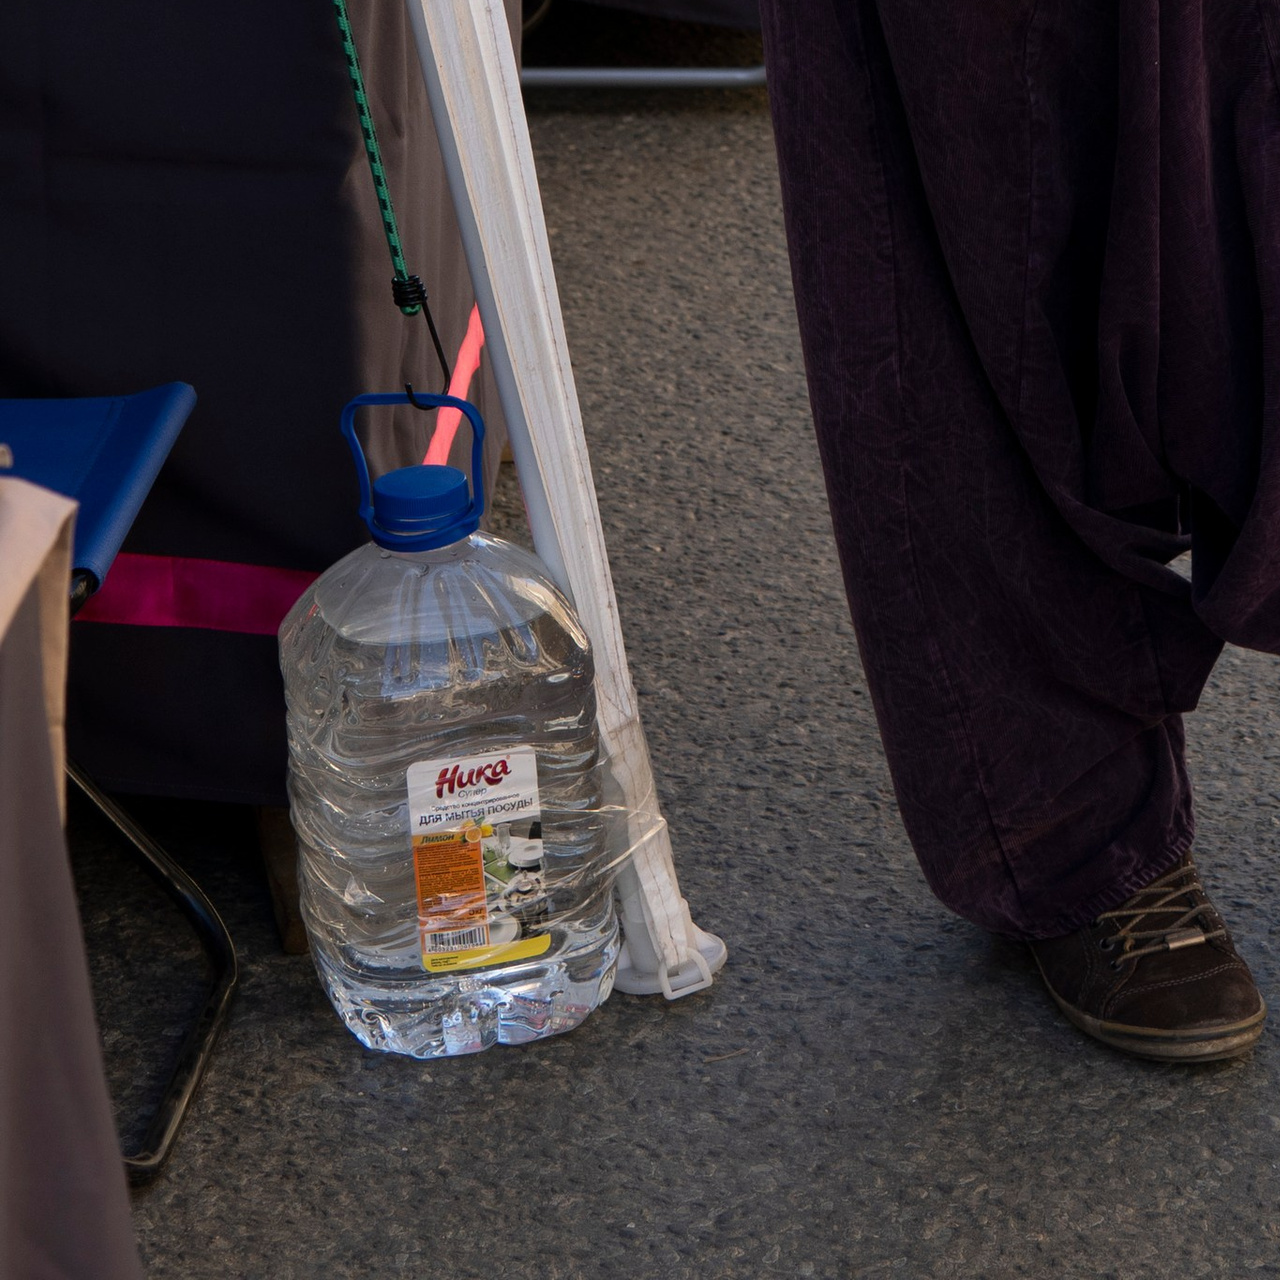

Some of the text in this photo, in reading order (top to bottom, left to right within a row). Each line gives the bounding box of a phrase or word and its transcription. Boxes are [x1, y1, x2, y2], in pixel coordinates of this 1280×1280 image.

[435, 758, 512, 799] Ника
[458, 787, 487, 799] Супер
[461, 792, 520, 808] концентрированное
[419, 797, 533, 827] ДЛЯ МЫТЬЯ ПОСУДЫ
